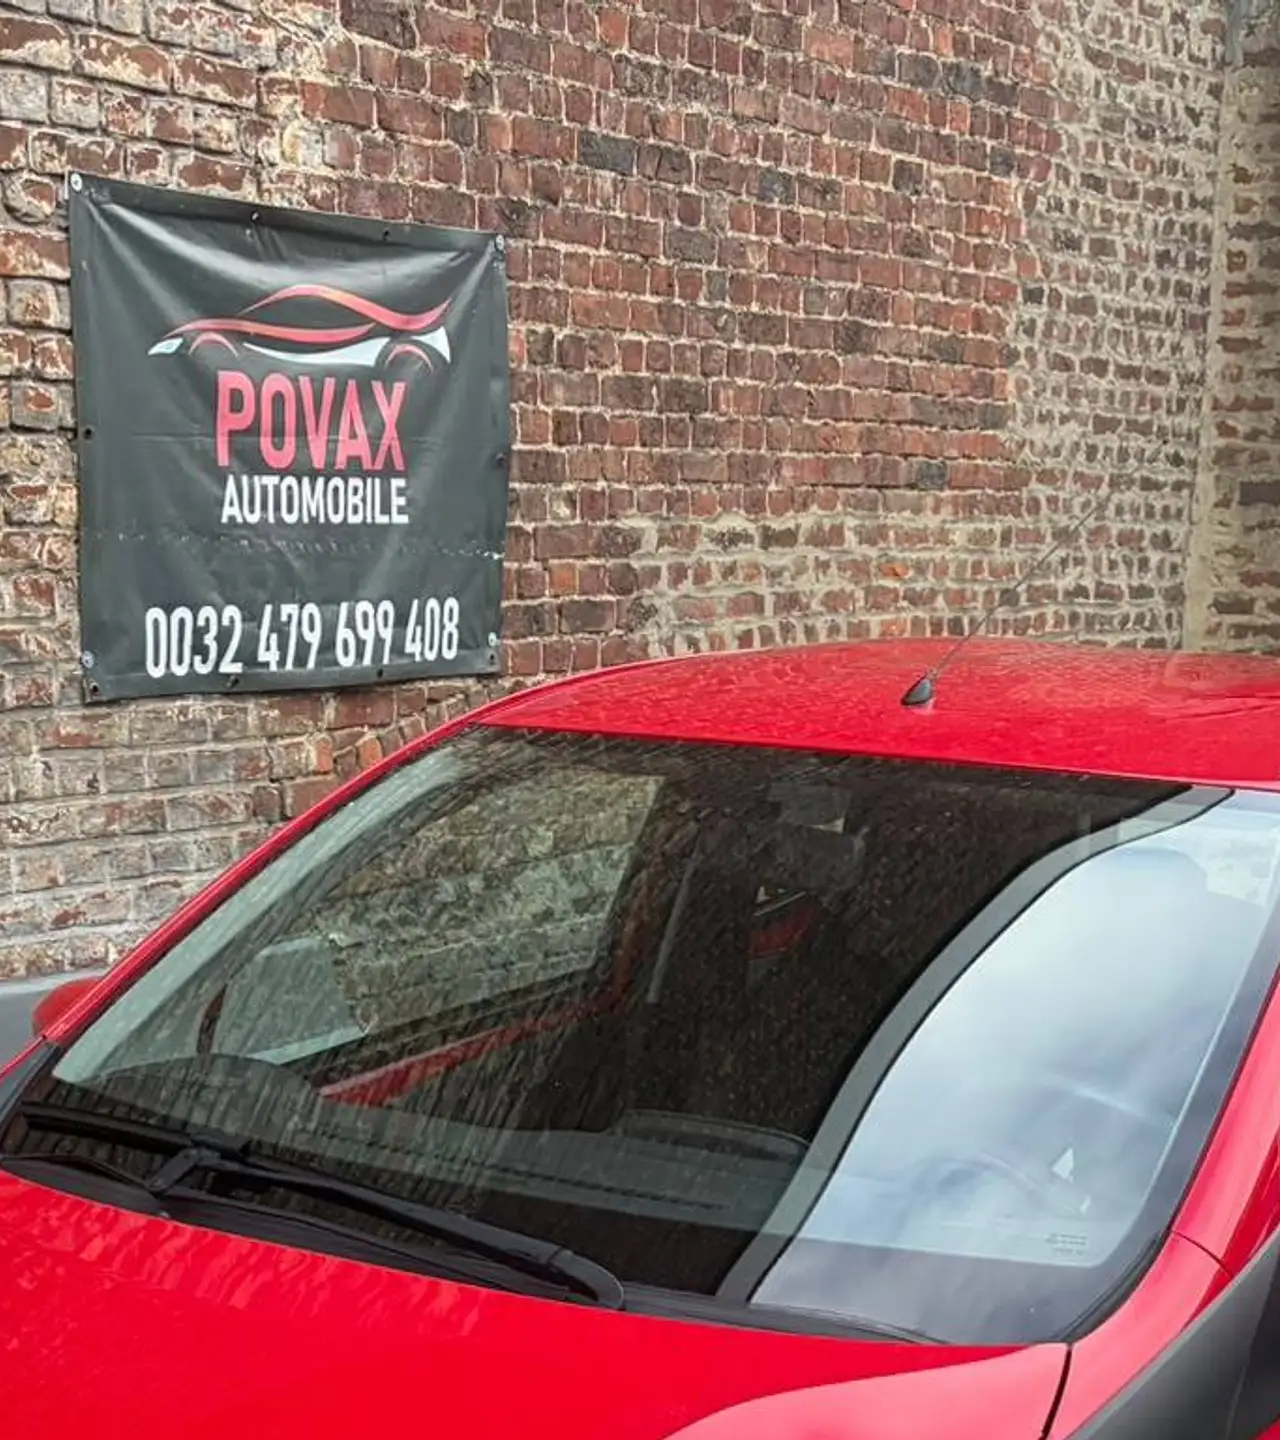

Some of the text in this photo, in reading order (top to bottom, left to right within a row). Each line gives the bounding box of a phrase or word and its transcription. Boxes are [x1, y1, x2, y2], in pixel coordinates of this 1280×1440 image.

[216, 370, 407, 472] POVAX
[221, 474, 409, 525] AUTOMOBILE
[145, 597, 460, 678] 0032 479 699 408
